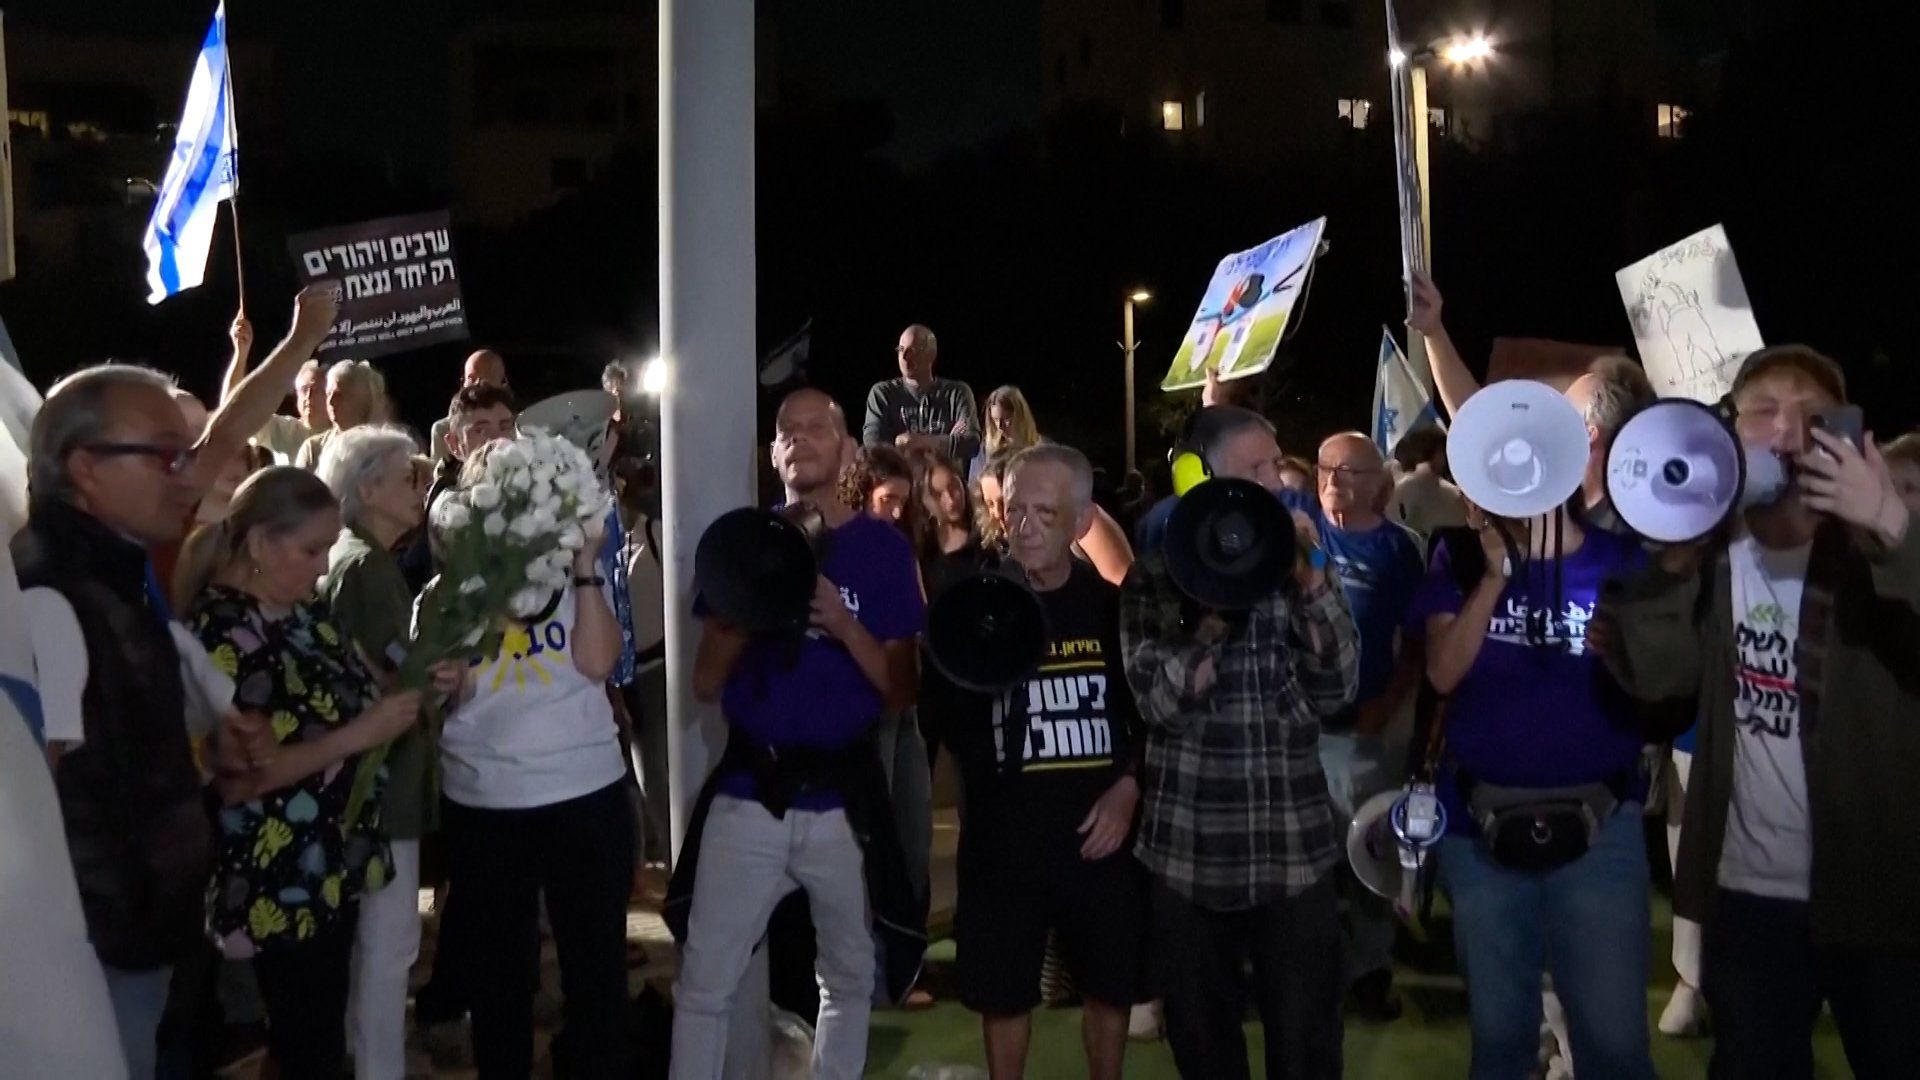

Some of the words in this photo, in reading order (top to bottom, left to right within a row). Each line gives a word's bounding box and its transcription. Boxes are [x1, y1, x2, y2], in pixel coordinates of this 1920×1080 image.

[303, 238, 388, 276] ויהודים
[390, 228, 450, 261] ערבים
[345, 268, 392, 300] ננצח
[393, 262, 428, 290] יחד
[429, 257, 456, 286] רק
